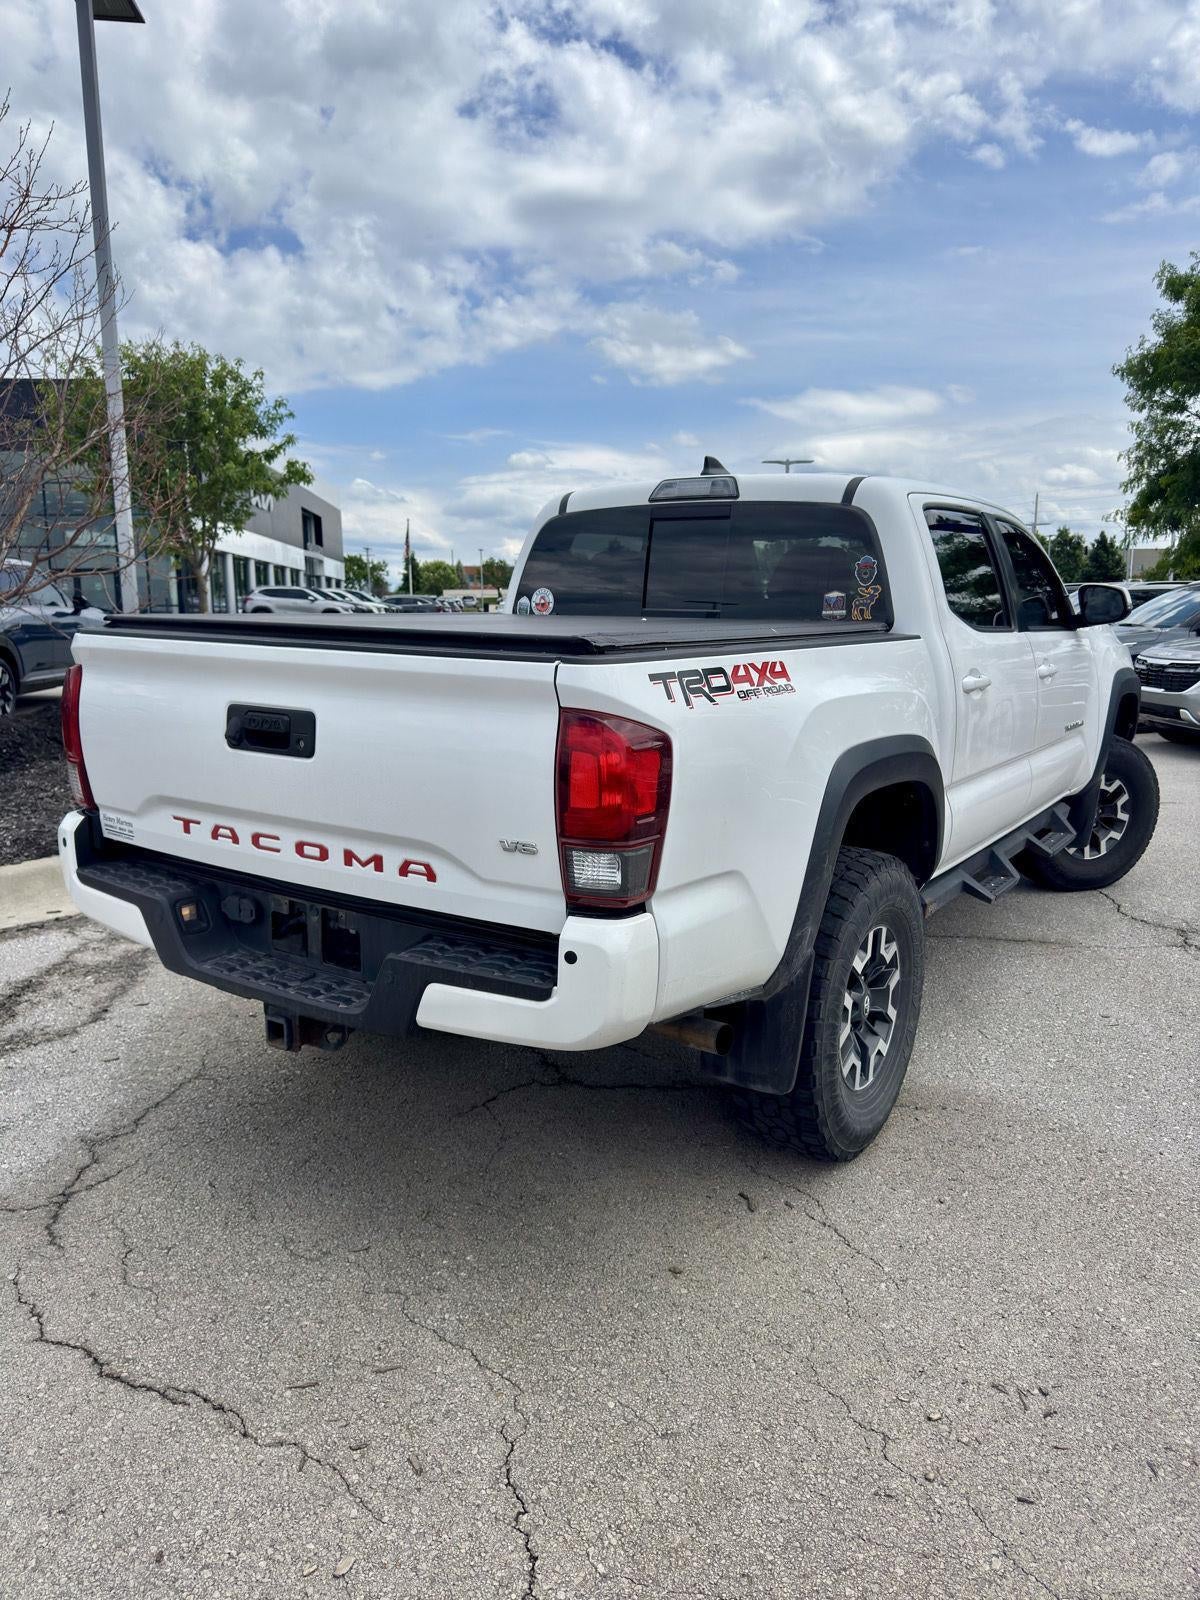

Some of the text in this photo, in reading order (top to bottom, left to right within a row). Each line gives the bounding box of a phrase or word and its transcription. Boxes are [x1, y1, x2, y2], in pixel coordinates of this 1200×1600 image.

[648, 661, 792, 709] TRD 4X4
[737, 683, 795, 700] OFF ROAD
[172, 815, 438, 883] TACOMA
[499, 839, 539, 855] V6
